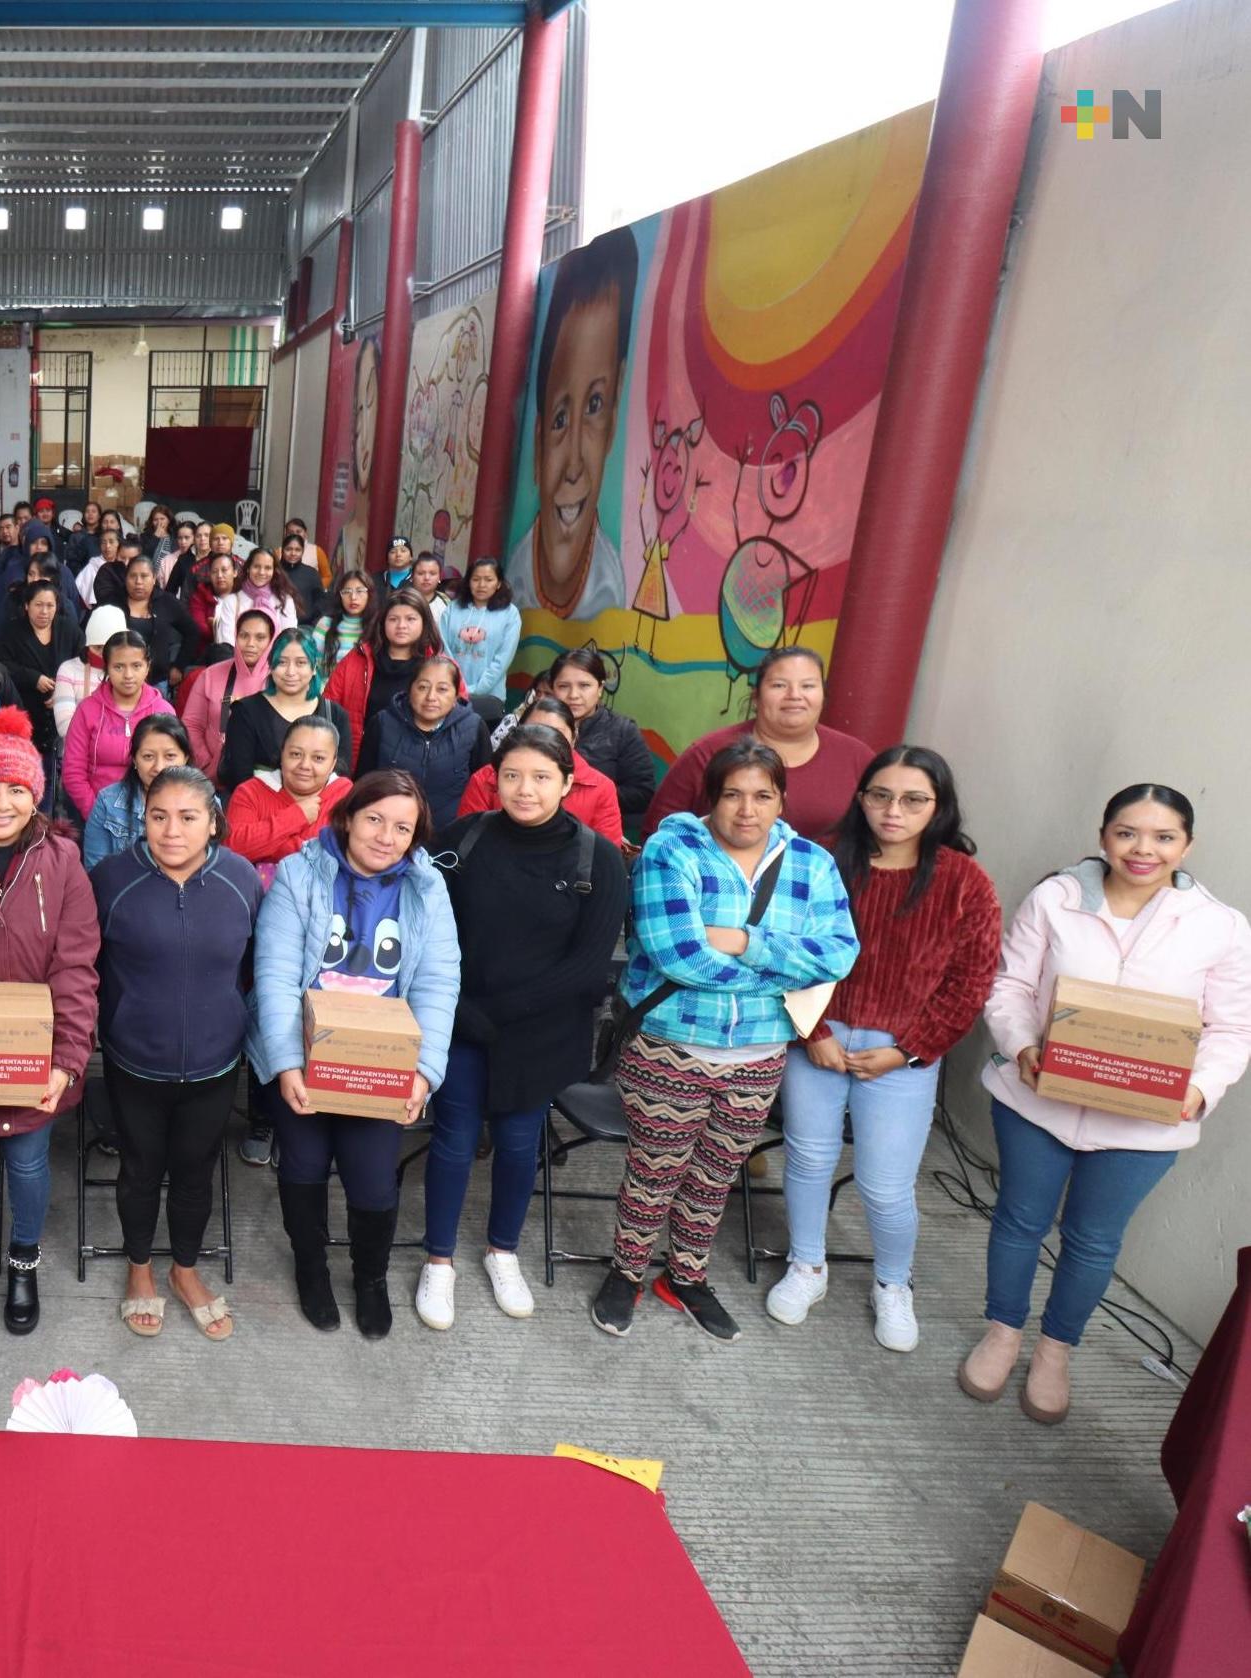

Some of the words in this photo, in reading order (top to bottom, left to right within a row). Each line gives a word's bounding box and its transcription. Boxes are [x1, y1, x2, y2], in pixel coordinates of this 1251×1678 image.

[6, 1064, 22, 1072] 1000
[23, 1064, 40, 1072] DÍAS
[1051, 1047, 1099, 1062] ATENCIÓN
[1101, 1057, 1166, 1076] ALIMENTARIA
[1168, 1069, 1182, 1078] EN
[314, 1065, 350, 1074] ATENCIÓN
[351, 1069, 398, 1079] ALIMENTARIA
[1055, 1055, 1072, 1064] LOS
[1075, 1059, 1124, 1075] PRIMEROS
[1126, 1070, 1149, 1080] 1000
[1151, 1073, 1175, 1085] DÍAS
[331, 1073, 368, 1083] PRIMEROS
[370, 1077, 386, 1085] 1000
[387, 1078, 404, 1087] DÍAS
